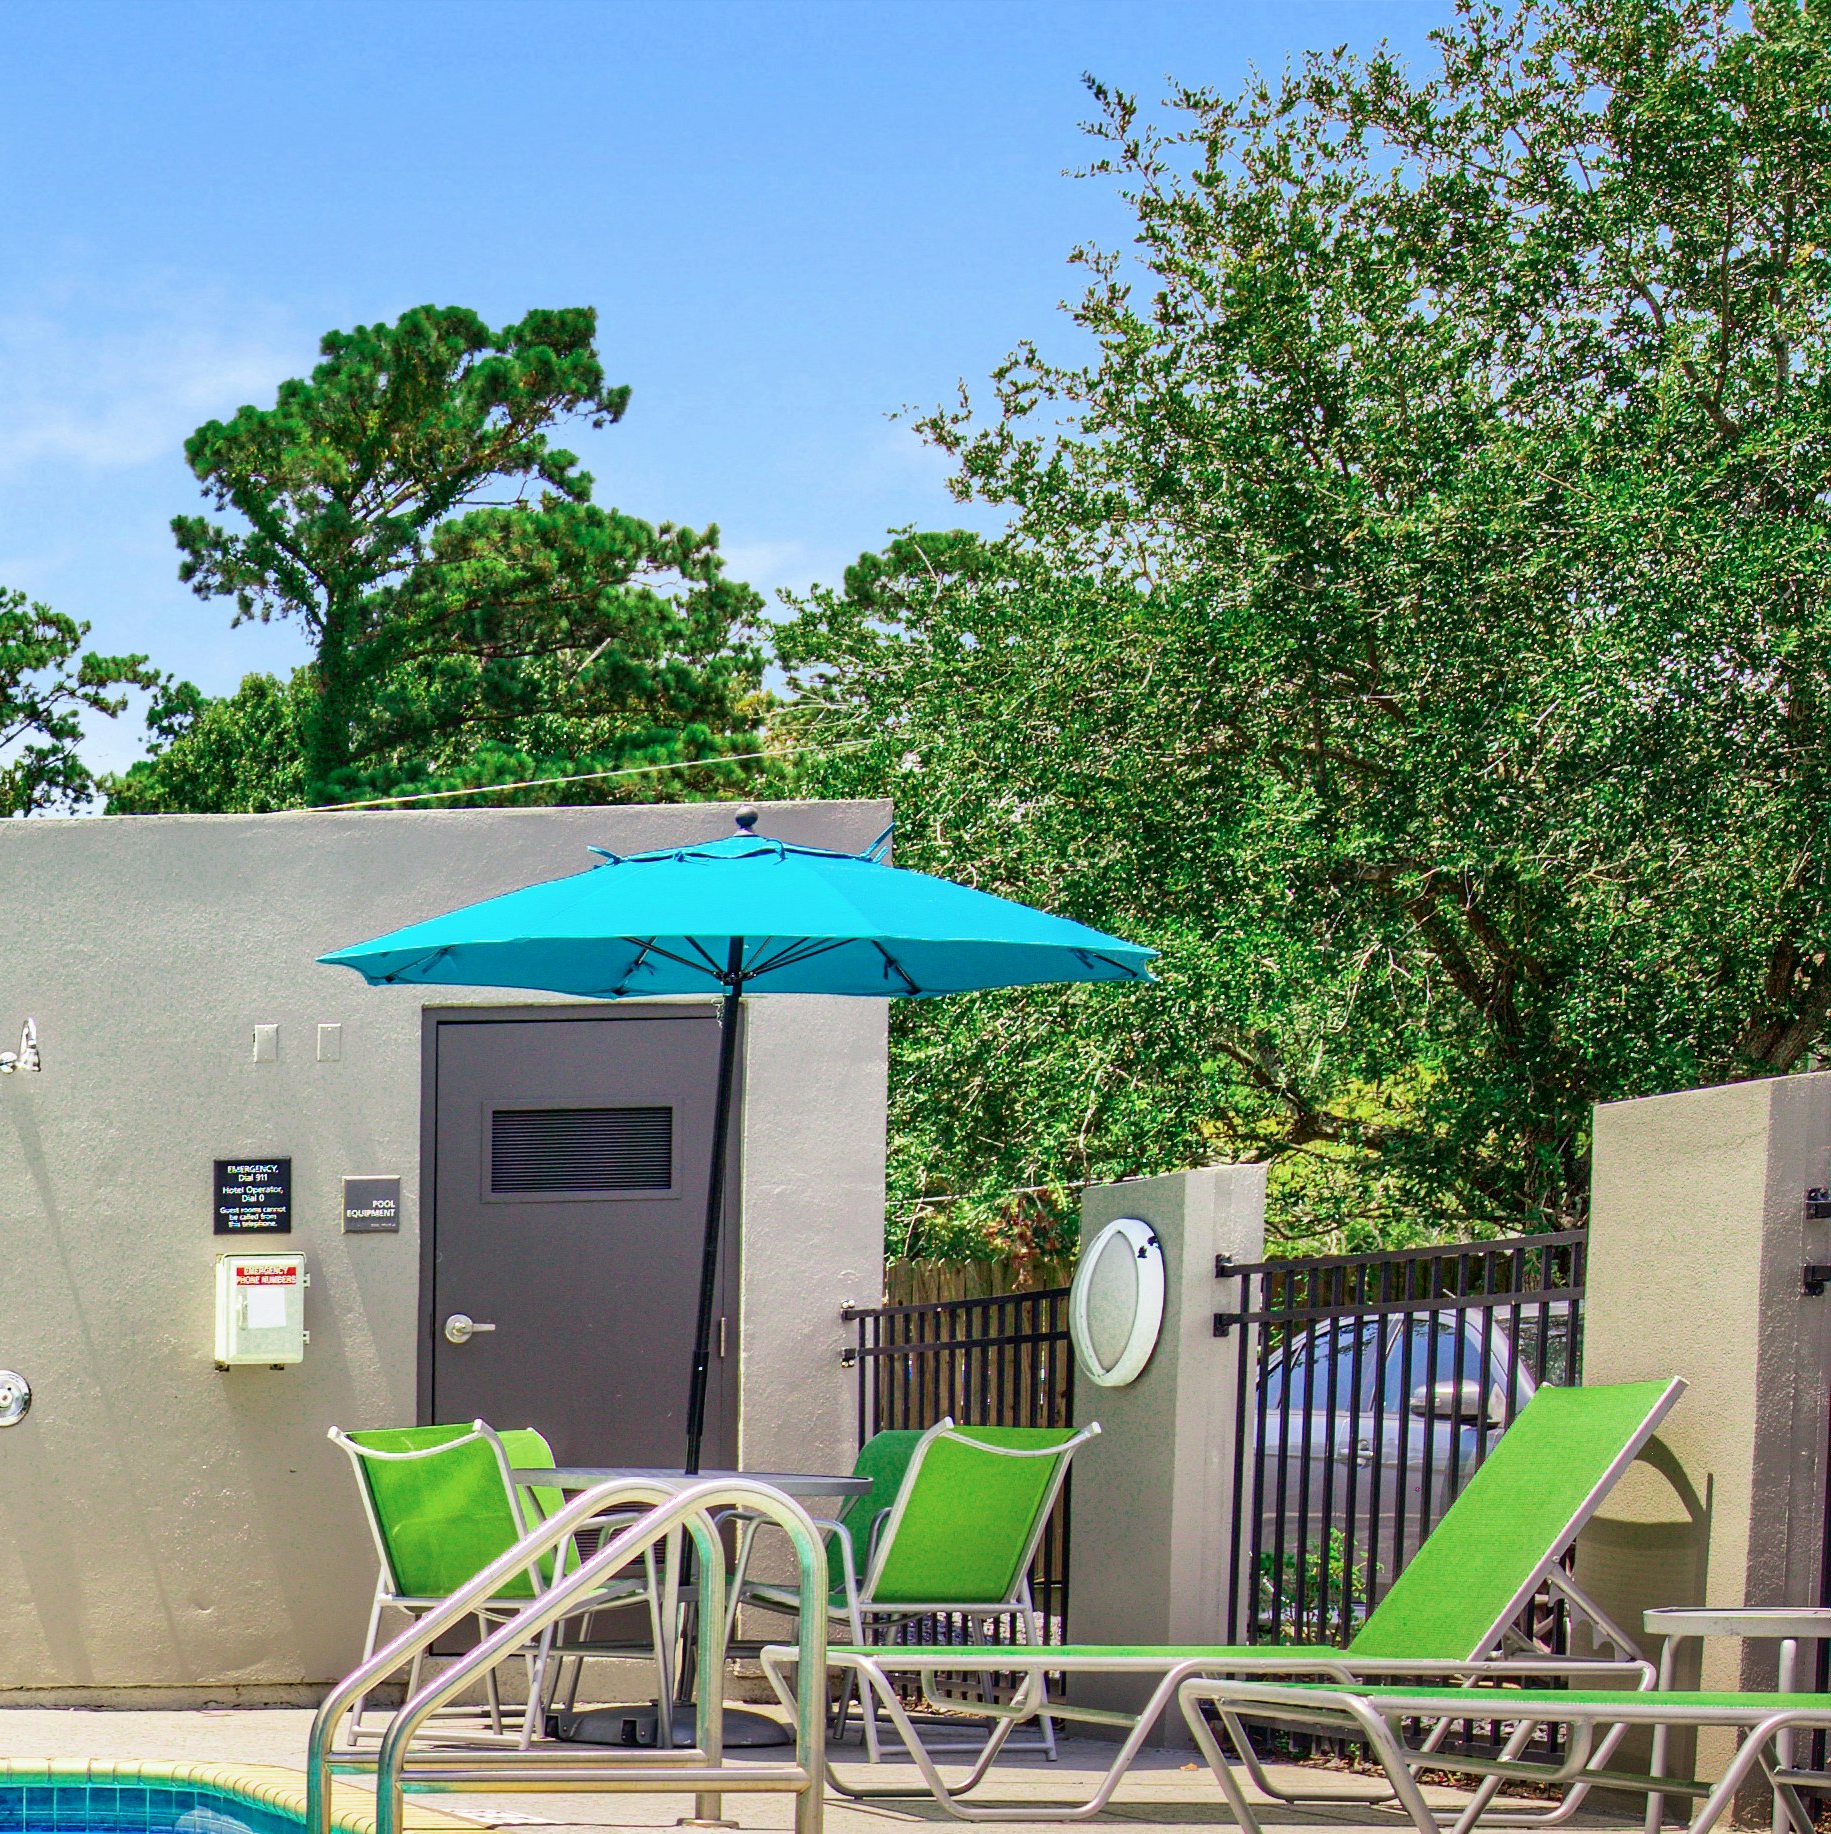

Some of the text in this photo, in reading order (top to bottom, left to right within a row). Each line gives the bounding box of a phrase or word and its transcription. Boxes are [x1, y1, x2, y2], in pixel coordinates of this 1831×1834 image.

[238, 1173, 268, 1182] Dial 911
[222, 1186, 244, 1194] Hotel
[241, 1194, 265, 1202] Dial 0
[372, 1200, 396, 1208] POOL
[346, 1209, 396, 1218] EQUIPMENT
[244, 1266, 288, 1275] EMERGENCY
[261, 1275, 297, 1284] NUMBERS
